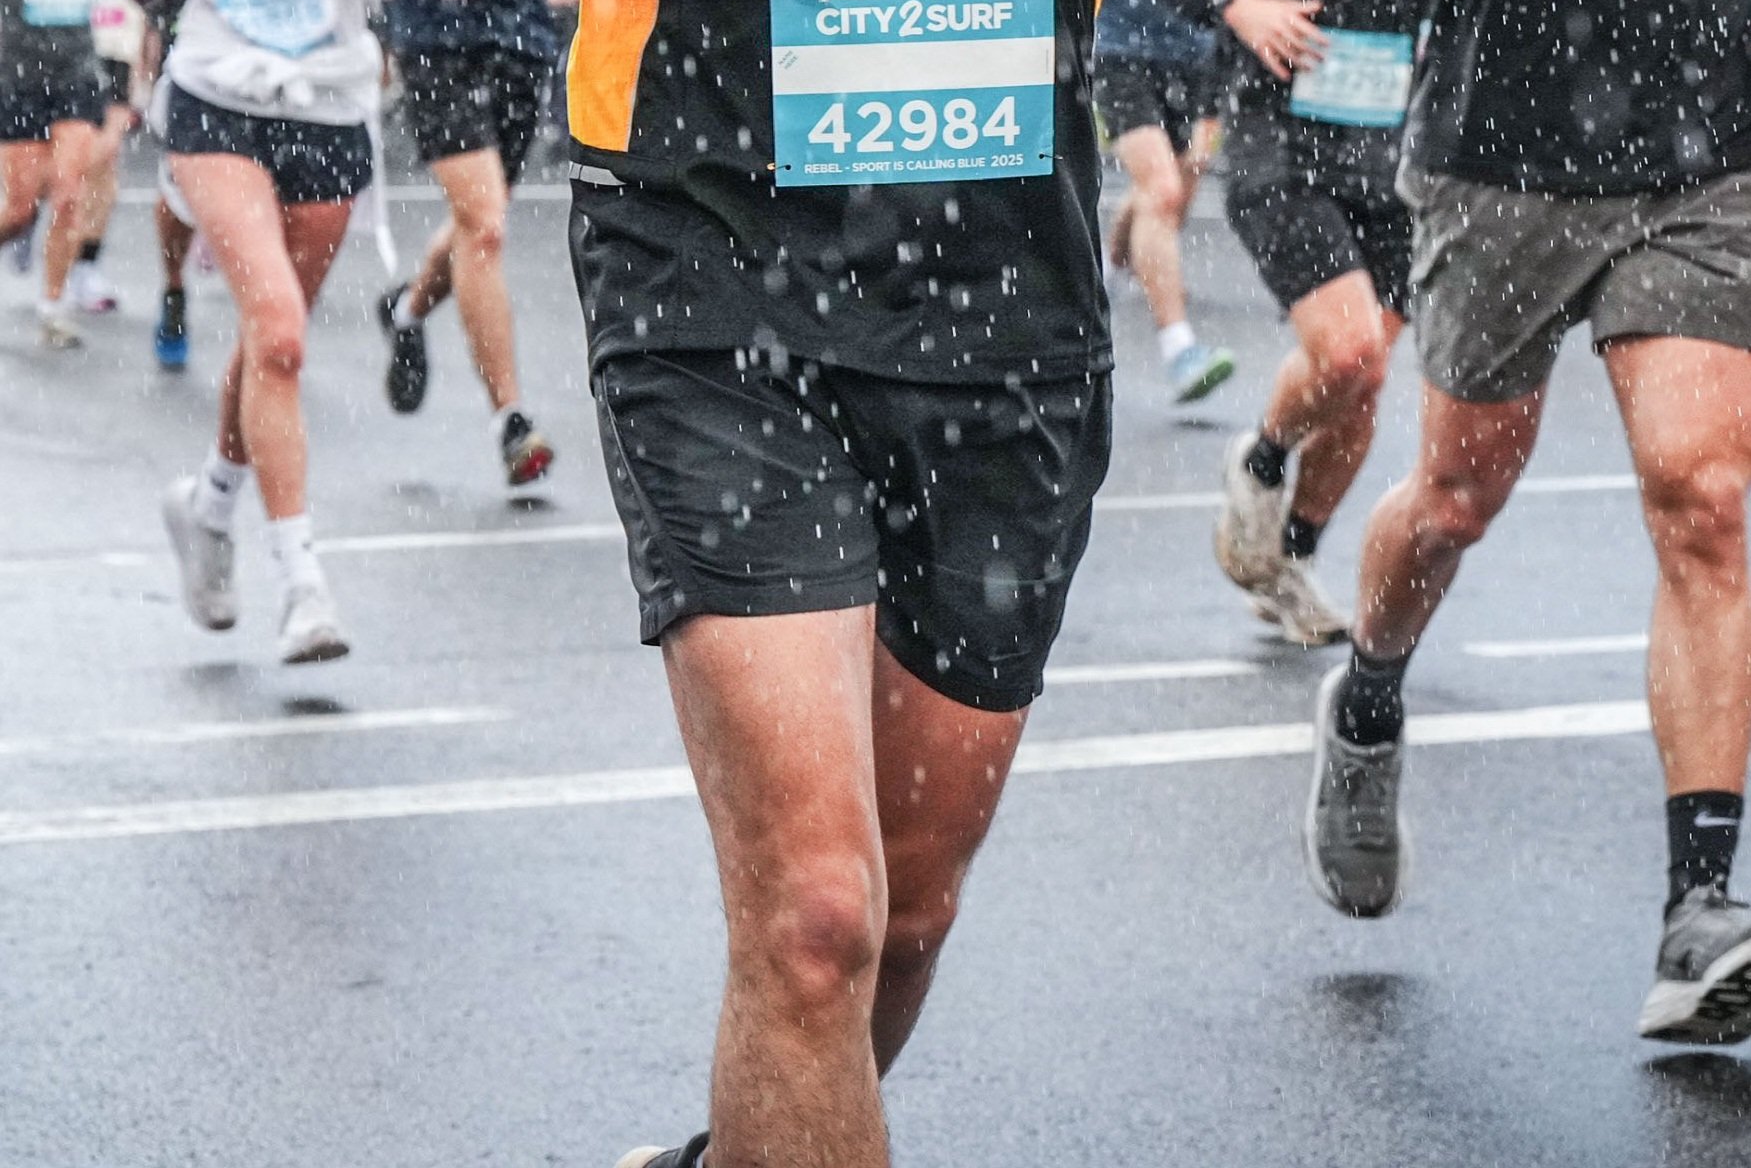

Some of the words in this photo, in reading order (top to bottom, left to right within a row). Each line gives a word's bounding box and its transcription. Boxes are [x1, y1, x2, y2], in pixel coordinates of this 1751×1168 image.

[807, 95, 1021, 154] 42984
[804, 163, 842, 174] REBEL
[852, 161, 891, 173] SPORT
[894, 161, 904, 171] IS
[906, 159, 956, 171] CALLING
[957, 157, 986, 168] BLUE
[990, 154, 1024, 167] 2025
